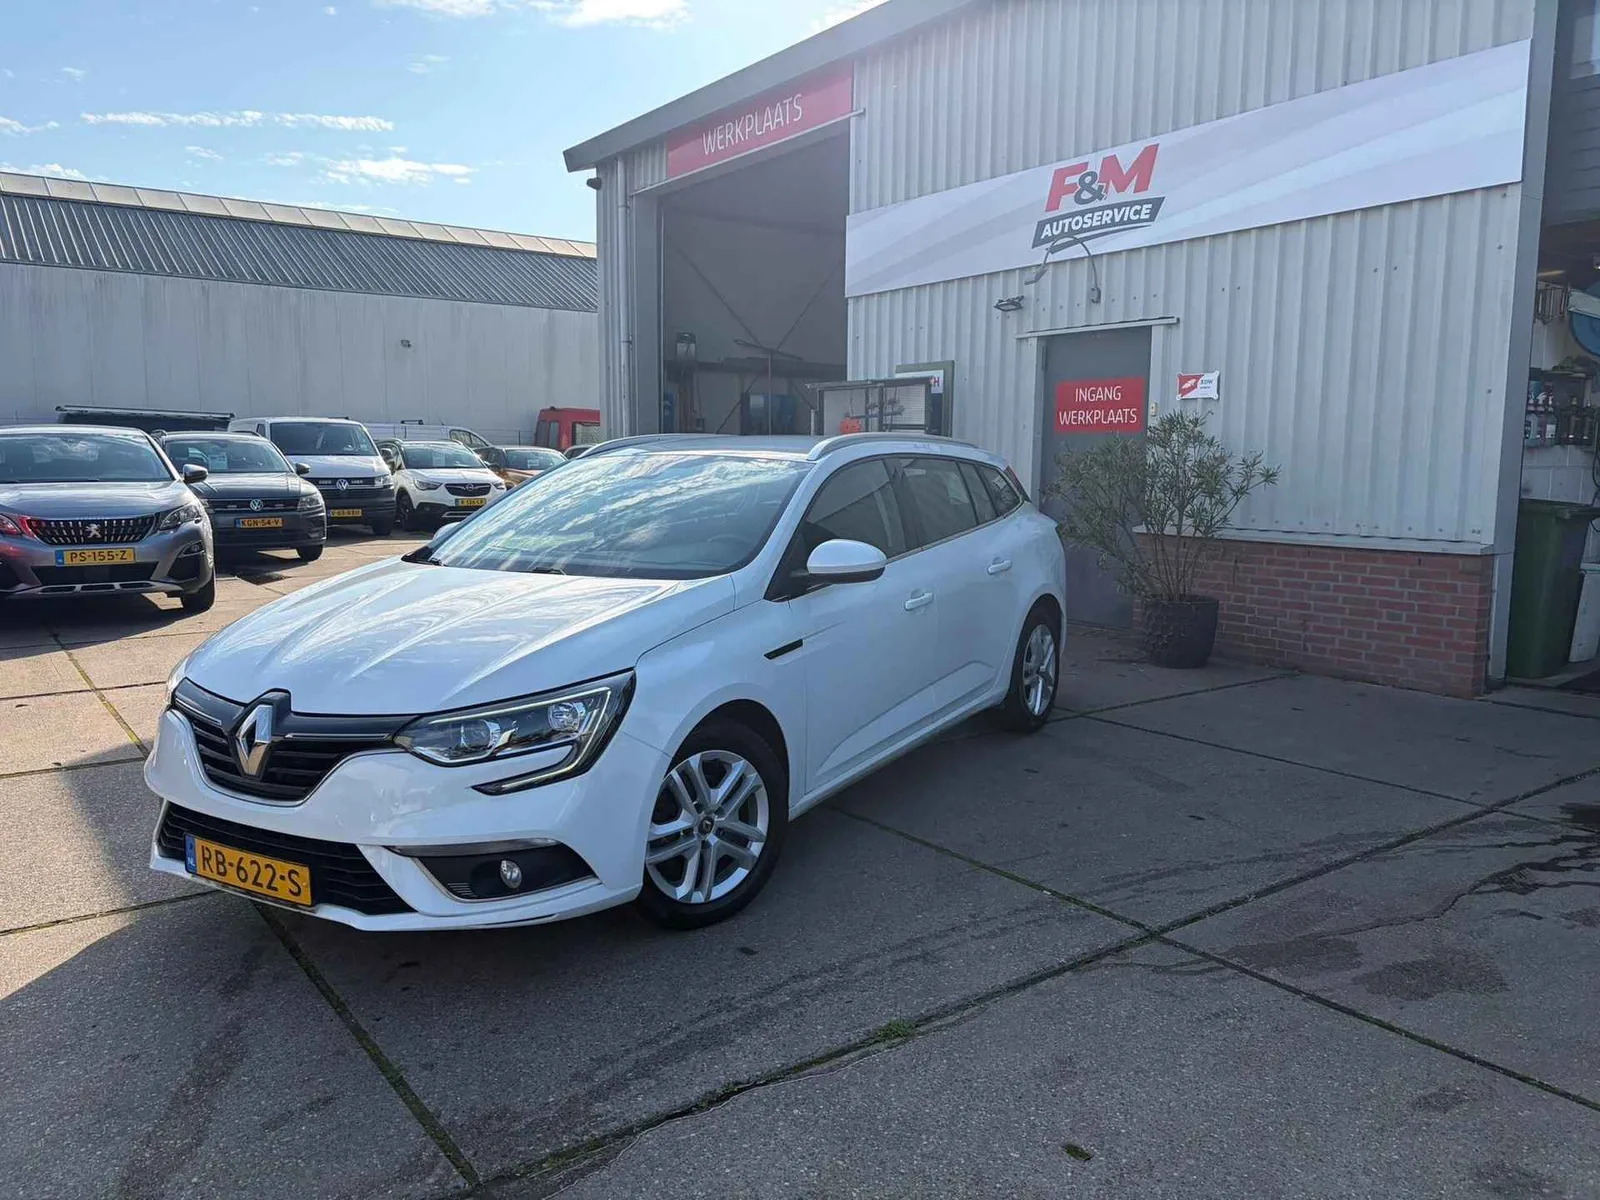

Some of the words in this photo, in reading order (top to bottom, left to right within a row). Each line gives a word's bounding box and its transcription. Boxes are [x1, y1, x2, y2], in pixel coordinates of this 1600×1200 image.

[701, 93, 804, 156] WERKPLAATS
[1045, 143, 1160, 213] F&M
[1040, 203, 1153, 239] AUTOSERVICE
[1075, 386, 1122, 403] INGANG
[1058, 408, 1138, 426] WERKPLAATS
[241, 519, 280, 527] KGN-54-V
[70, 550, 128, 562] PS-155-Z
[201, 845, 302, 897] RB-622-S
